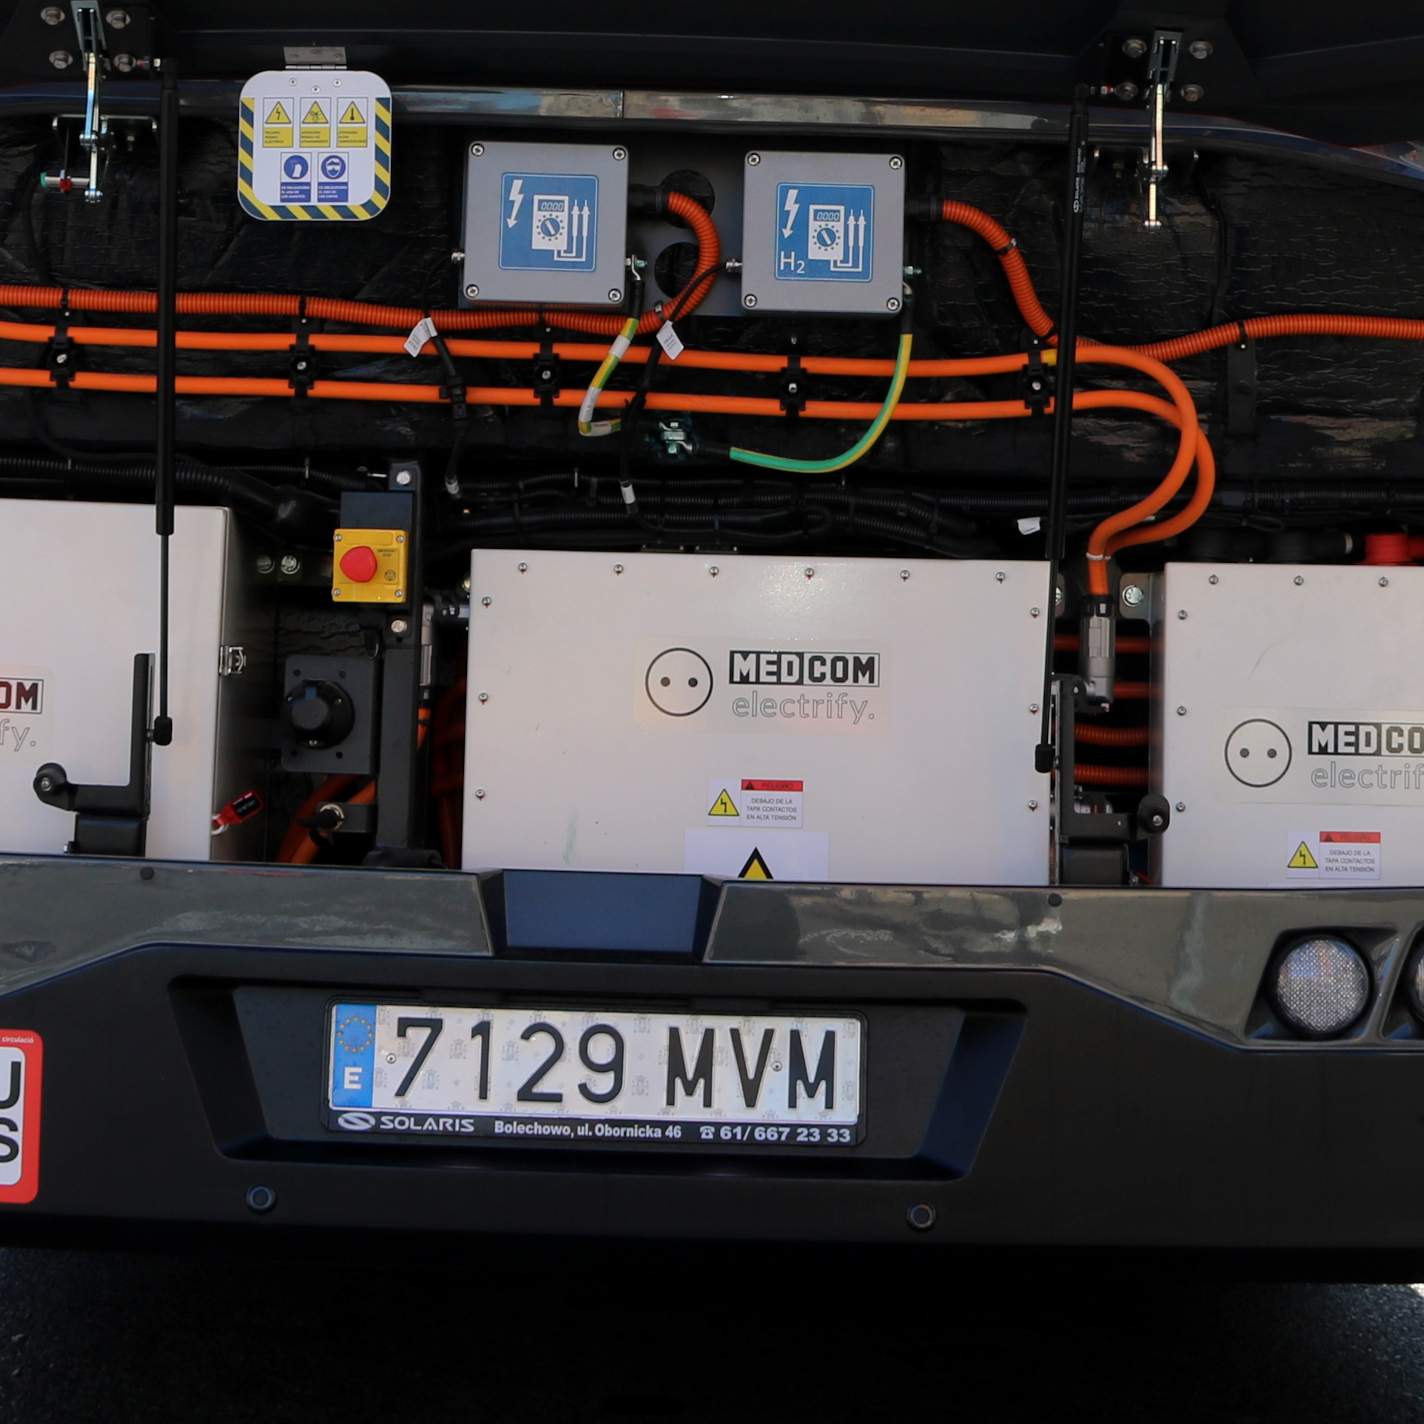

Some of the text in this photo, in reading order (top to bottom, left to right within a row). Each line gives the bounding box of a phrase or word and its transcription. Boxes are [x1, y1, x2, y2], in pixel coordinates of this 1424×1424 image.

[732, 651, 876, 686] MEDCOM
[731, 691, 876, 724] electrify.
[771, 813, 797, 821] TENSIÓN
[344, 1016, 835, 1110] E 7129 MVM
[380, 1116, 475, 1133] SOLARIS
[494, 1121, 575, 1139] Bolechowo,
[577, 1124, 593, 1137] ul.
[595, 1124, 662, 1139] Obornicka
[665, 1126, 682, 1139] 46
[796, 1127, 820, 1143] 23
[826, 1127, 851, 1143] 33
